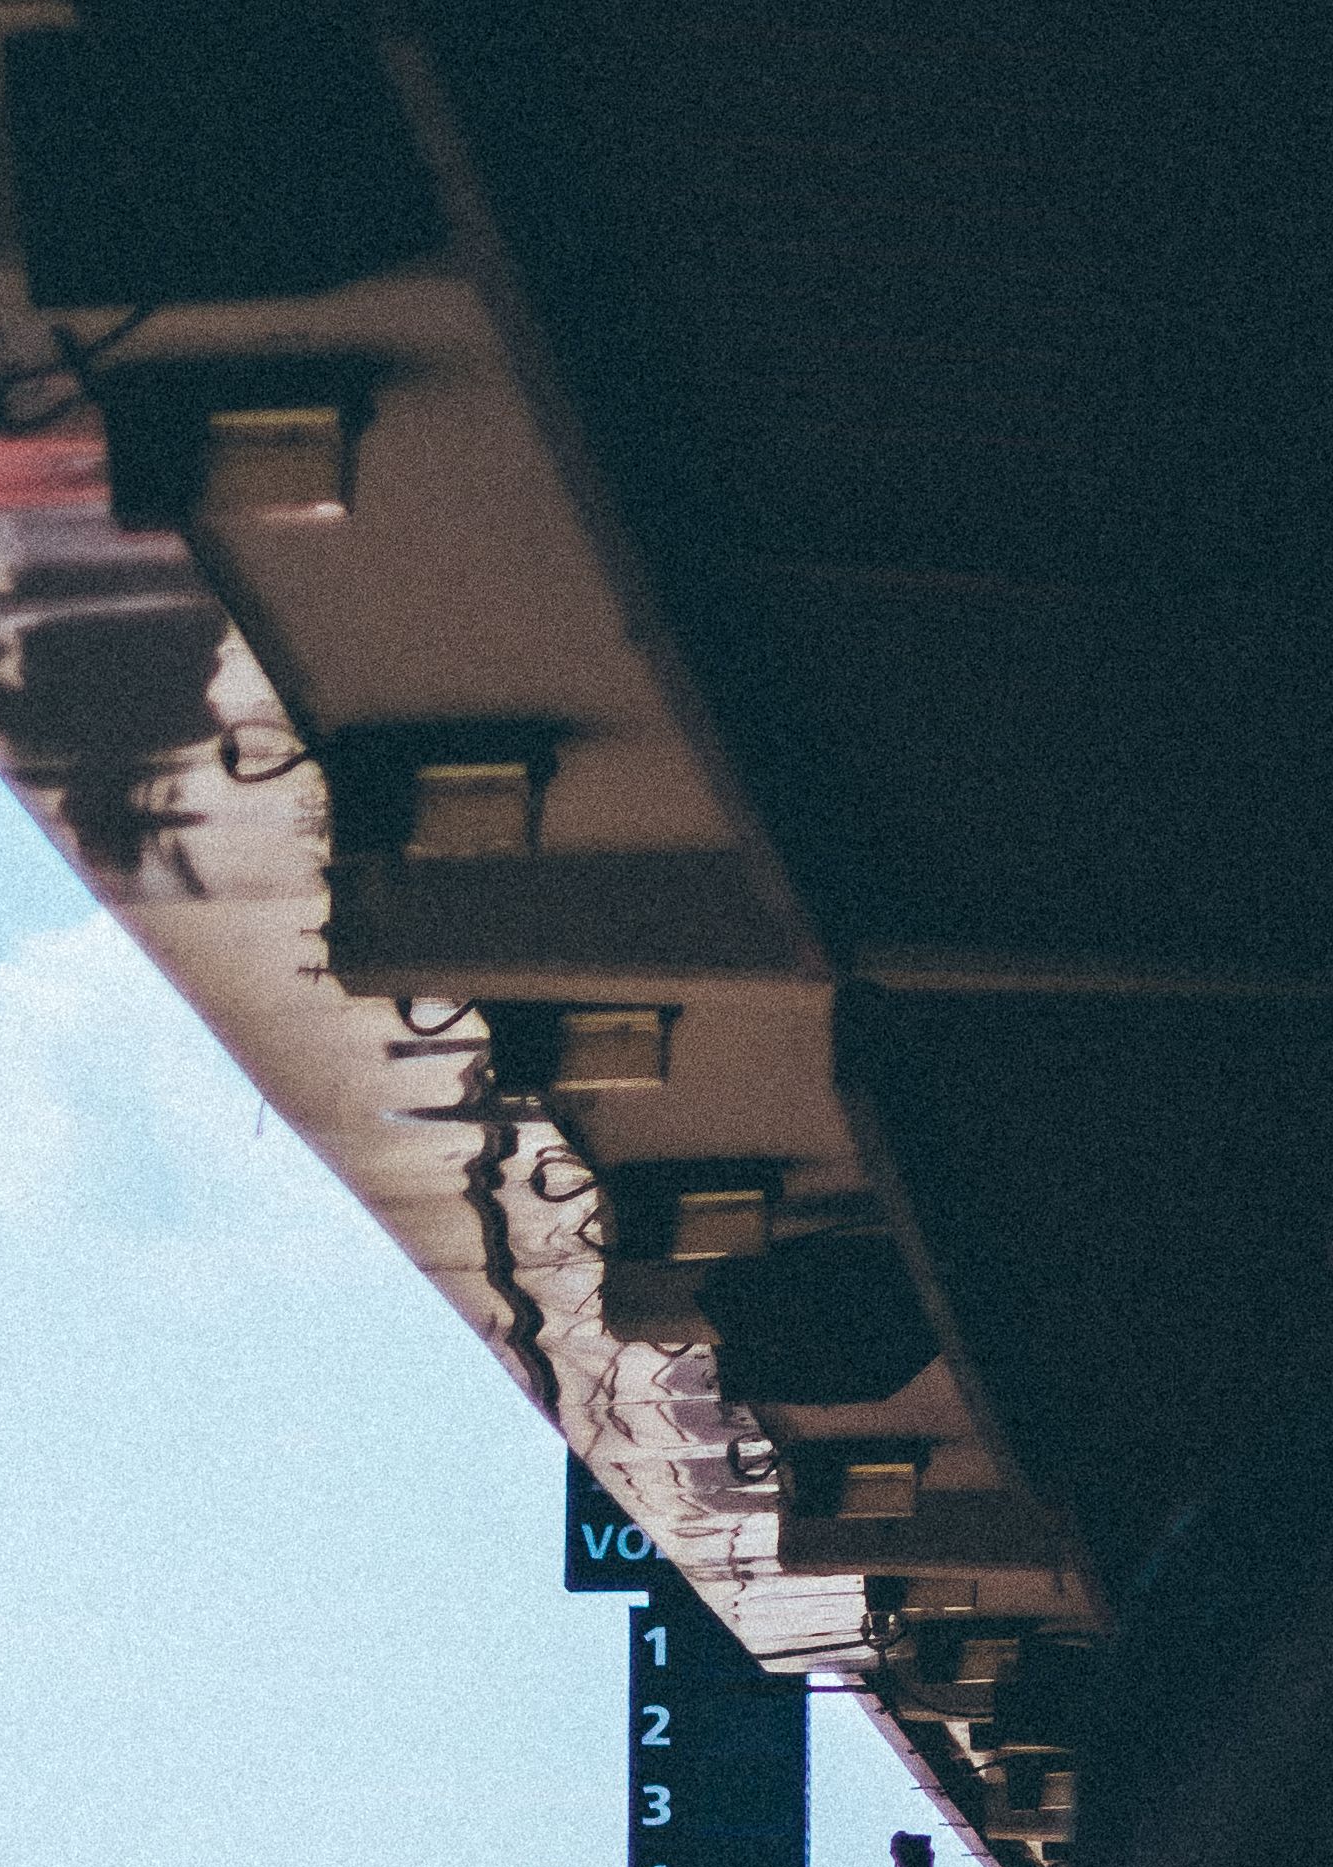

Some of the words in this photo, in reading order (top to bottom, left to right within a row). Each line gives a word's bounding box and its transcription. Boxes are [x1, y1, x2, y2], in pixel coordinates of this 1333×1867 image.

[581, 1523, 667, 1561] VO
[643, 1626, 667, 1667] 1
[641, 1705, 672, 1747] 2
[641, 1784, 673, 1827] 3
